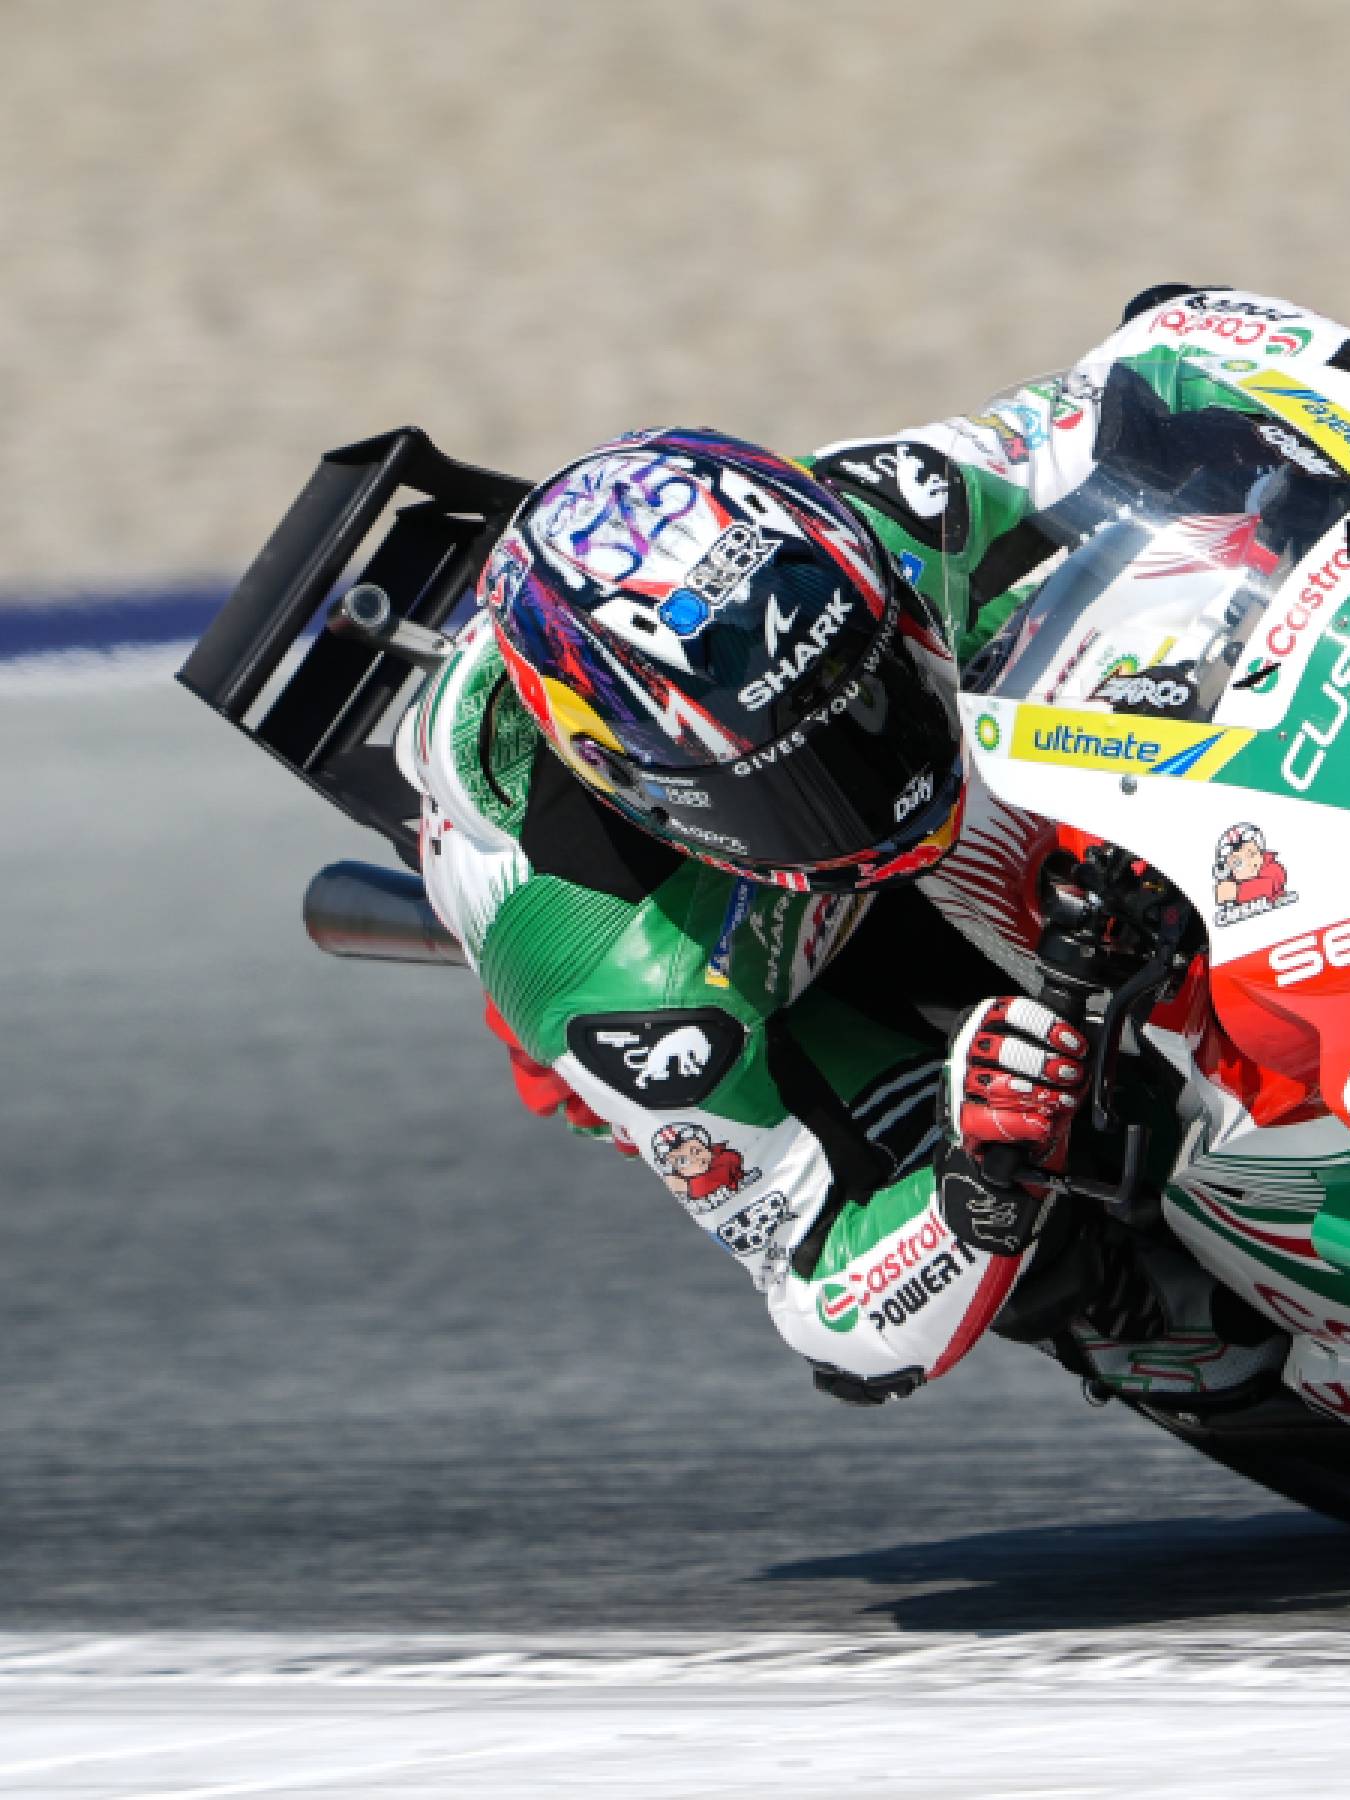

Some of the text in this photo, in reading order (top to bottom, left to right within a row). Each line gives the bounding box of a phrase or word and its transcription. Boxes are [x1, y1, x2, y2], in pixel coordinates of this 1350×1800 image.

[732, 597, 901, 777] GIVES YOU WINGS
[737, 587, 853, 711] SHARK
[1032, 723, 1161, 763] ultimate
[849, 1211, 948, 1309] Castrol
